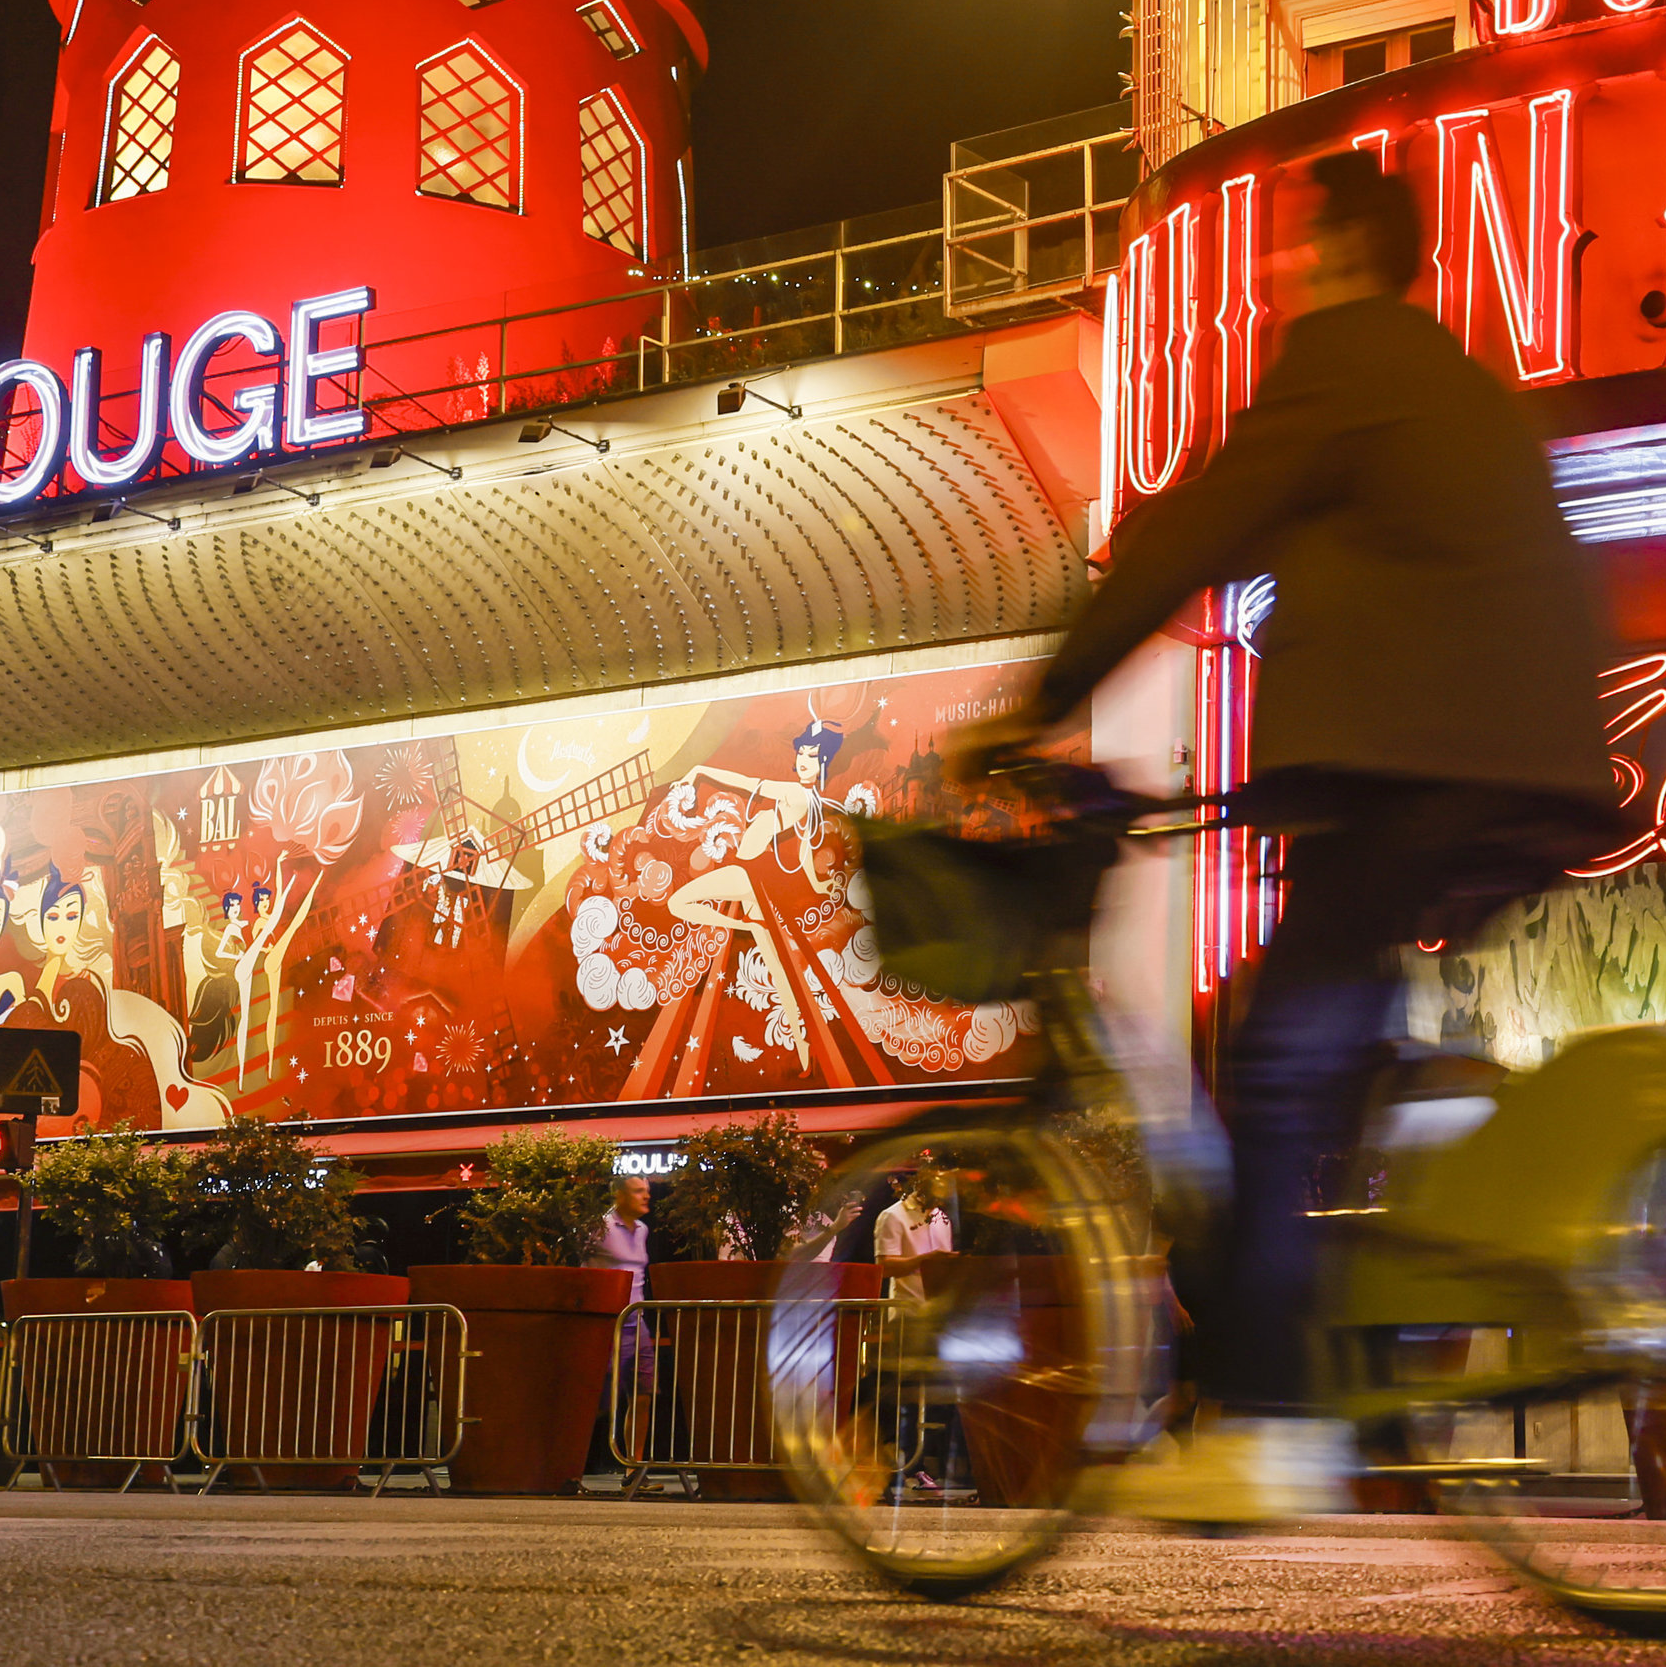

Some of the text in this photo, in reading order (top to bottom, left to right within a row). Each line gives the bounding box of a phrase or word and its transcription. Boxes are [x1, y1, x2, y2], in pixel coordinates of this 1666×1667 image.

[199, 795, 241, 844] BAL
[313, 1012, 394, 1027] DEPUIS SINCE
[323, 1029, 392, 1074] 1889
